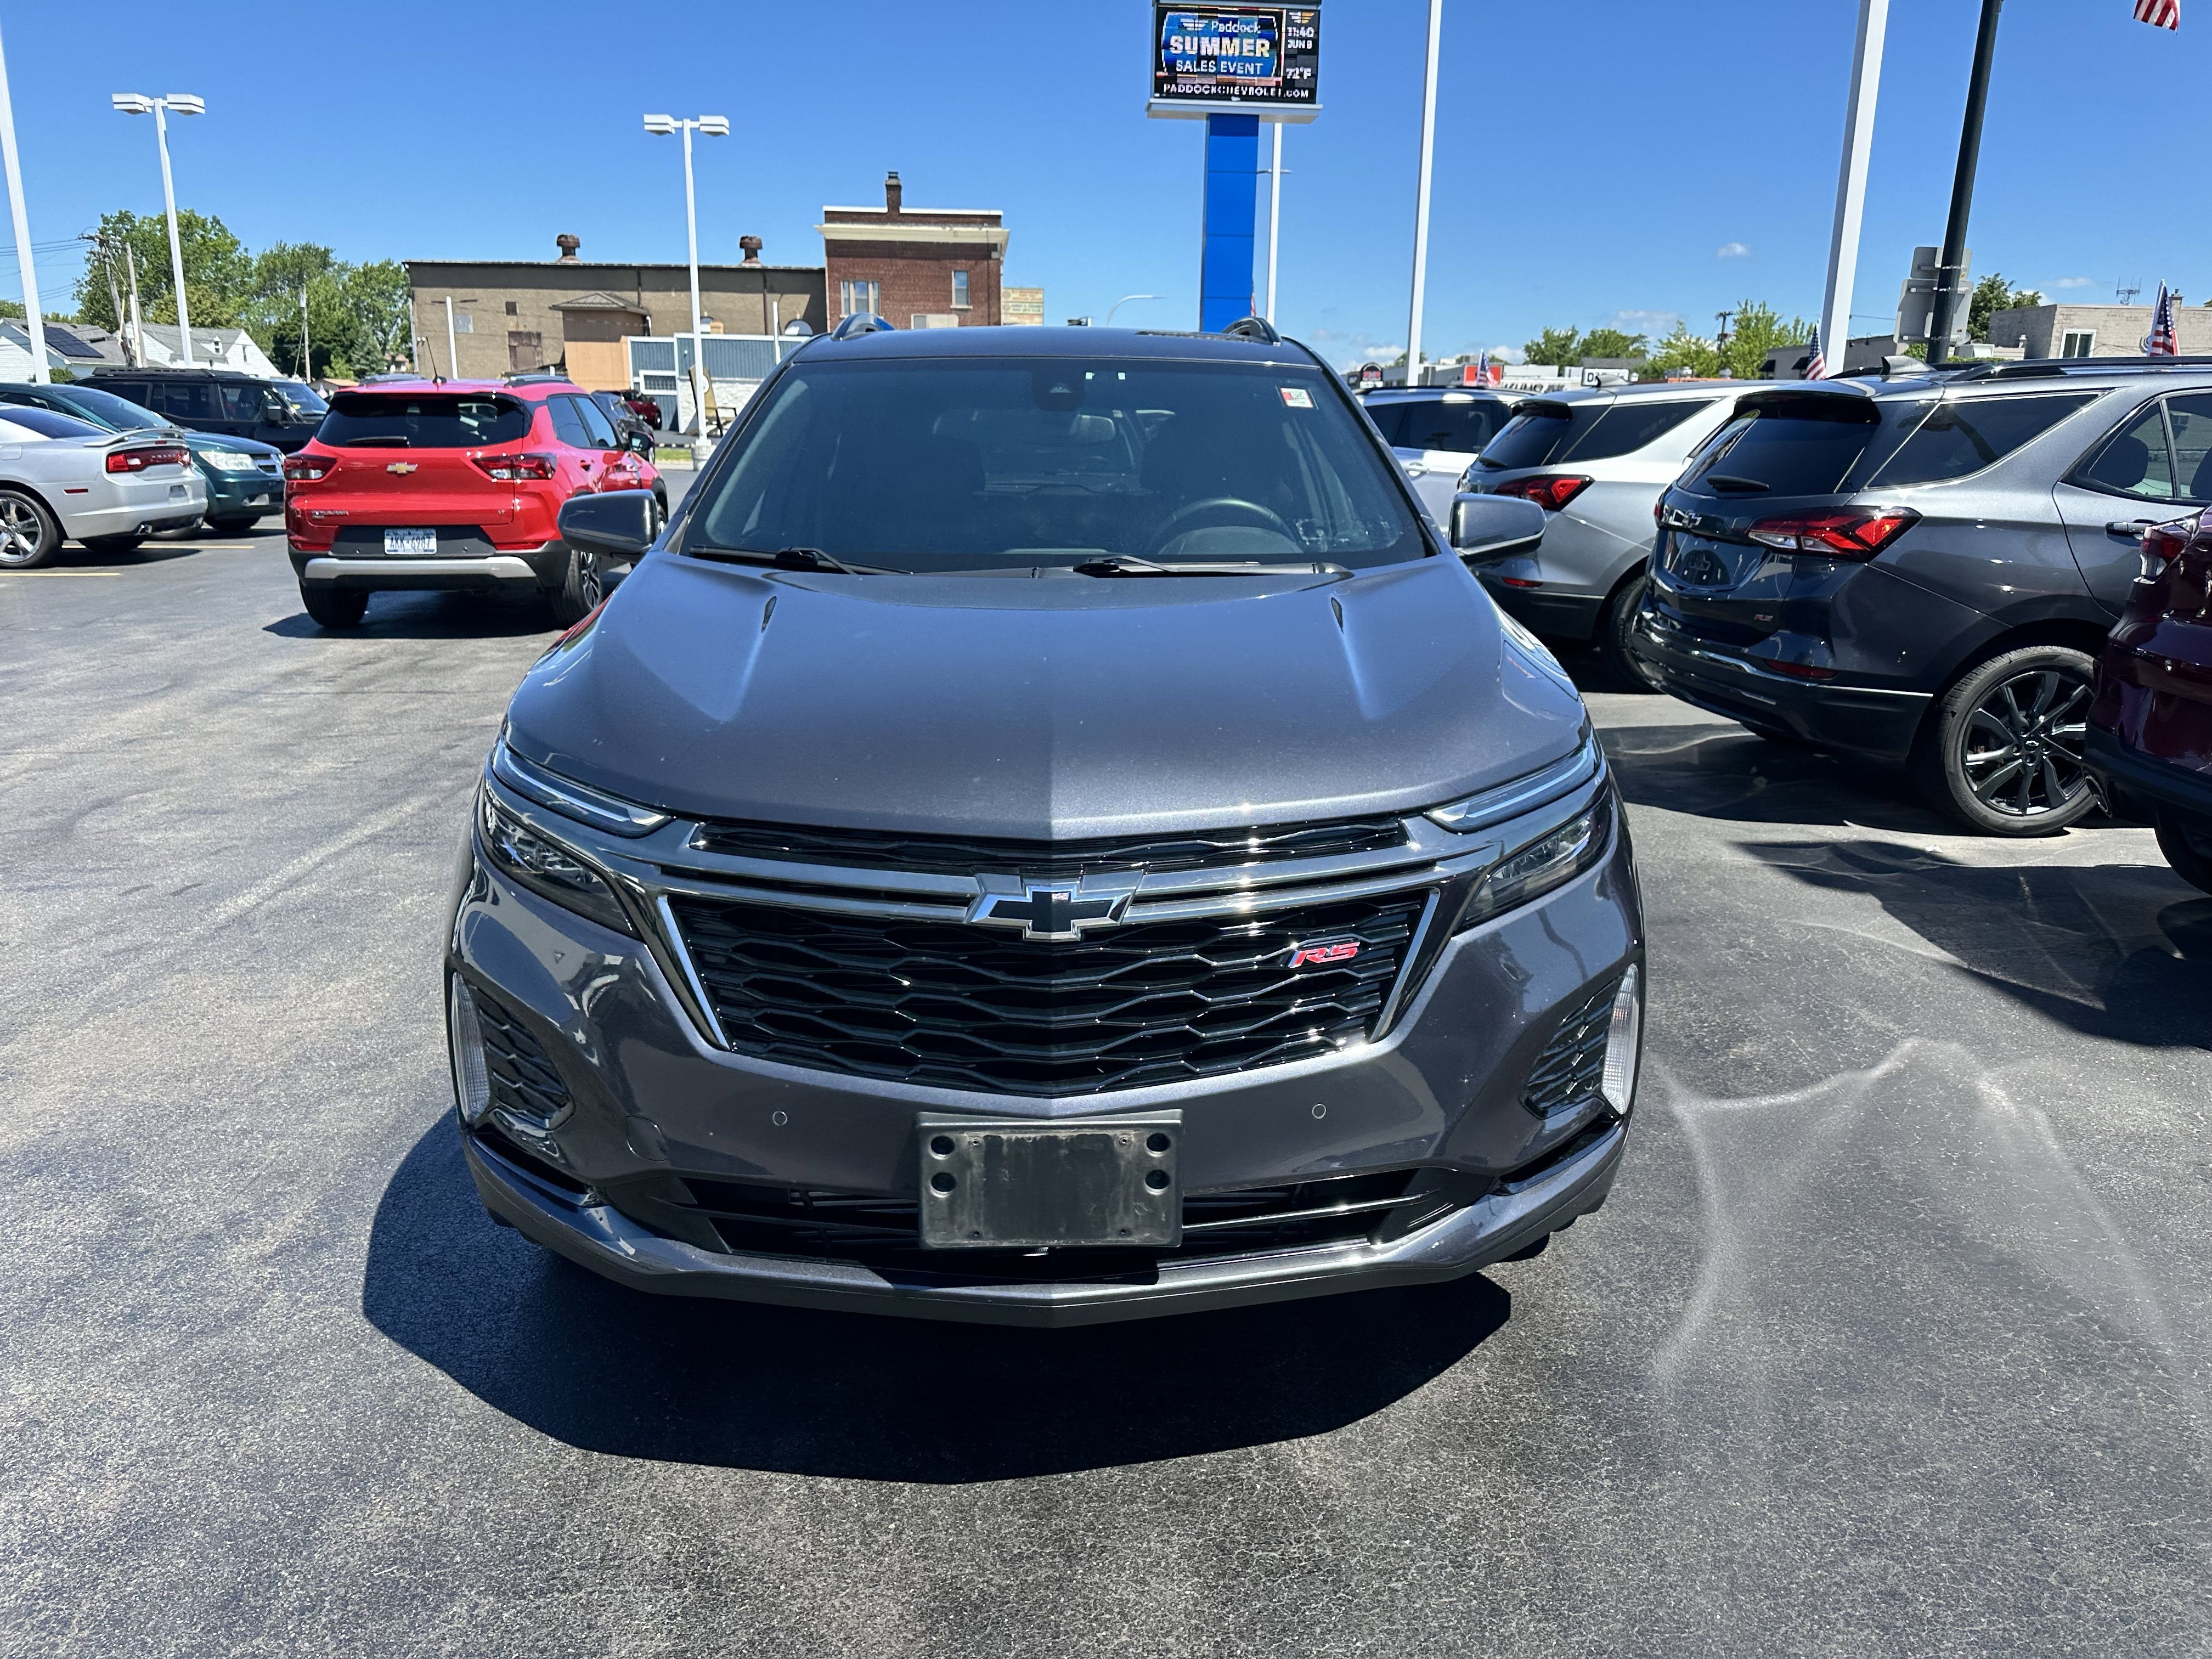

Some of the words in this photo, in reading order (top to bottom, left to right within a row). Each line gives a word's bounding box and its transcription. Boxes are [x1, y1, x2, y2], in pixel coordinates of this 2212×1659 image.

[1211, 20, 1261, 33] Paddock
[1286, 26, 1314, 37] 11:40
[1170, 36, 1269, 58] SUMMER
[1287, 39, 1306, 49] JUN
[1176, 59, 1216, 73] SALES
[1220, 60, 1263, 75] EVENT
[1288, 941, 1361, 969] RS
